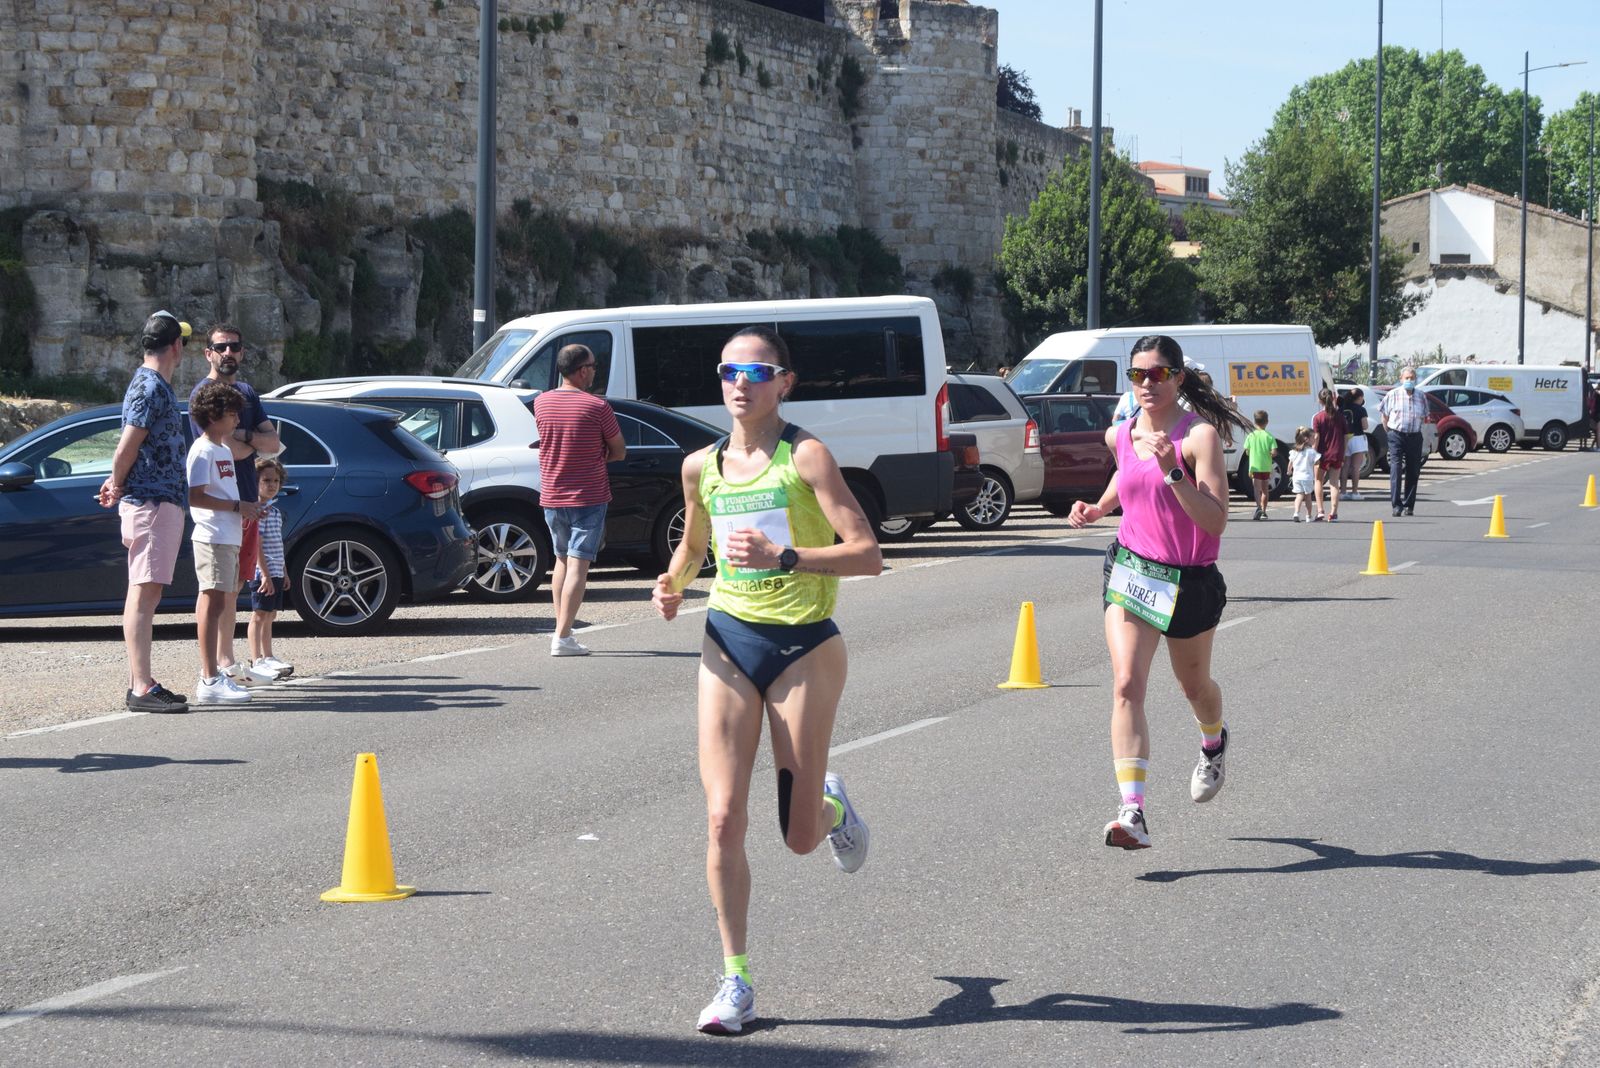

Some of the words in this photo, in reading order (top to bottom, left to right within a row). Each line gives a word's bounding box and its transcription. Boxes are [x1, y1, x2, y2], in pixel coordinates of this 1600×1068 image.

[1535, 378, 1568, 389] Hertz
[726, 503, 745, 513] CAJA
[747, 500, 776, 511] RURAL
[1125, 582, 1158, 607] NEREA
[1125, 600, 1141, 612] CAJA
[1142, 609, 1165, 625] RURAL
